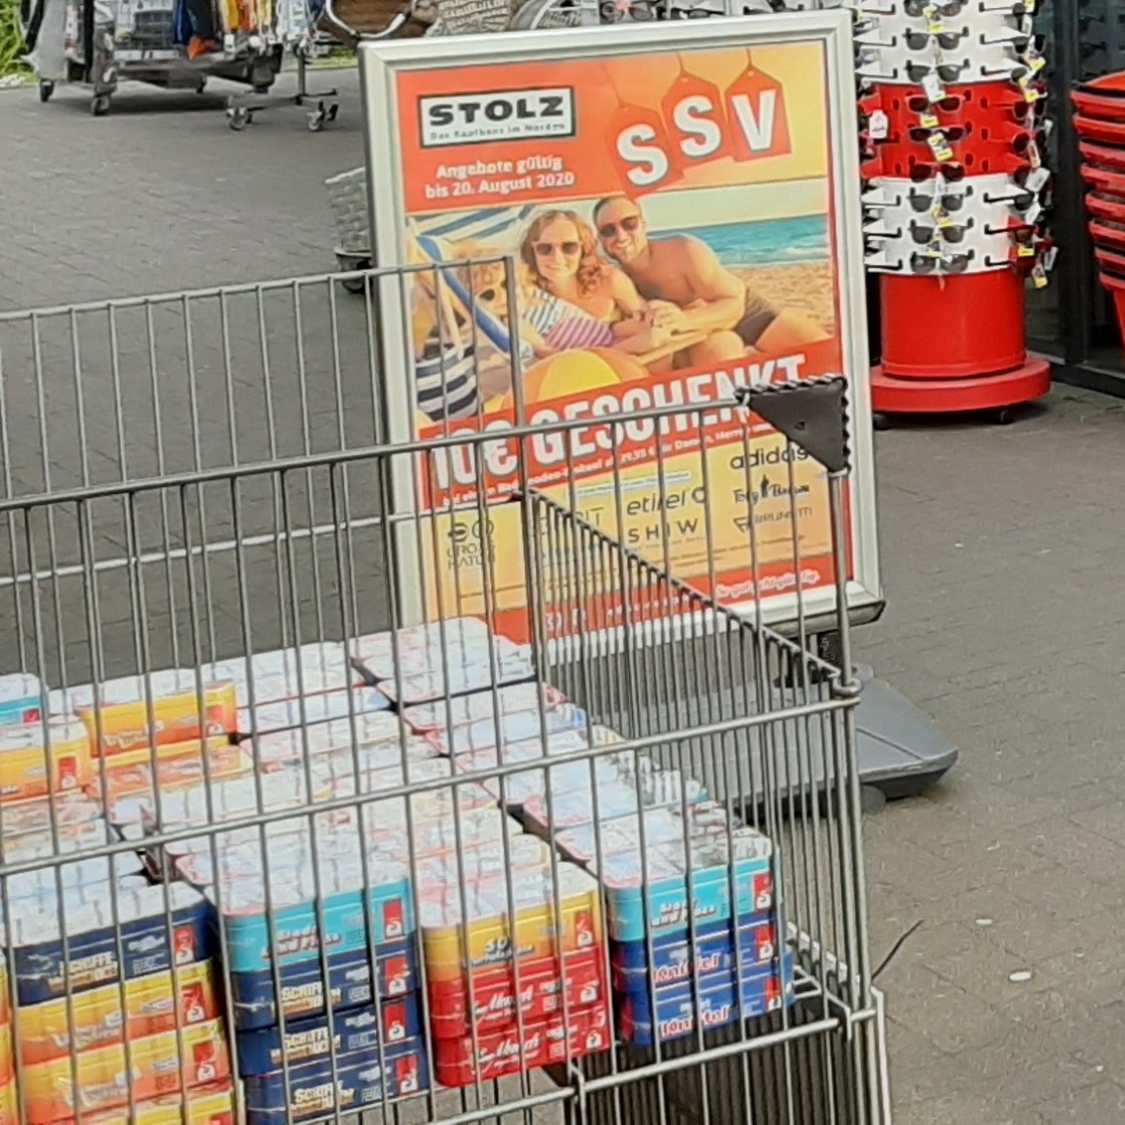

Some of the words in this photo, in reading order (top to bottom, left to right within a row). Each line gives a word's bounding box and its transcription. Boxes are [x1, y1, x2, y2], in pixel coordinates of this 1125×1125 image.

[428, 95, 564, 127] STOLZ
[616, 88, 777, 186] SSV
[436, 159, 513, 180] Angebote
[516, 154, 563, 174] gültig
[425, 183, 449, 199] bis
[452, 180, 476, 196] 20.
[479, 176, 533, 196] August
[536, 171, 575, 188] 2020
[729, 446, 809, 470] adidas
